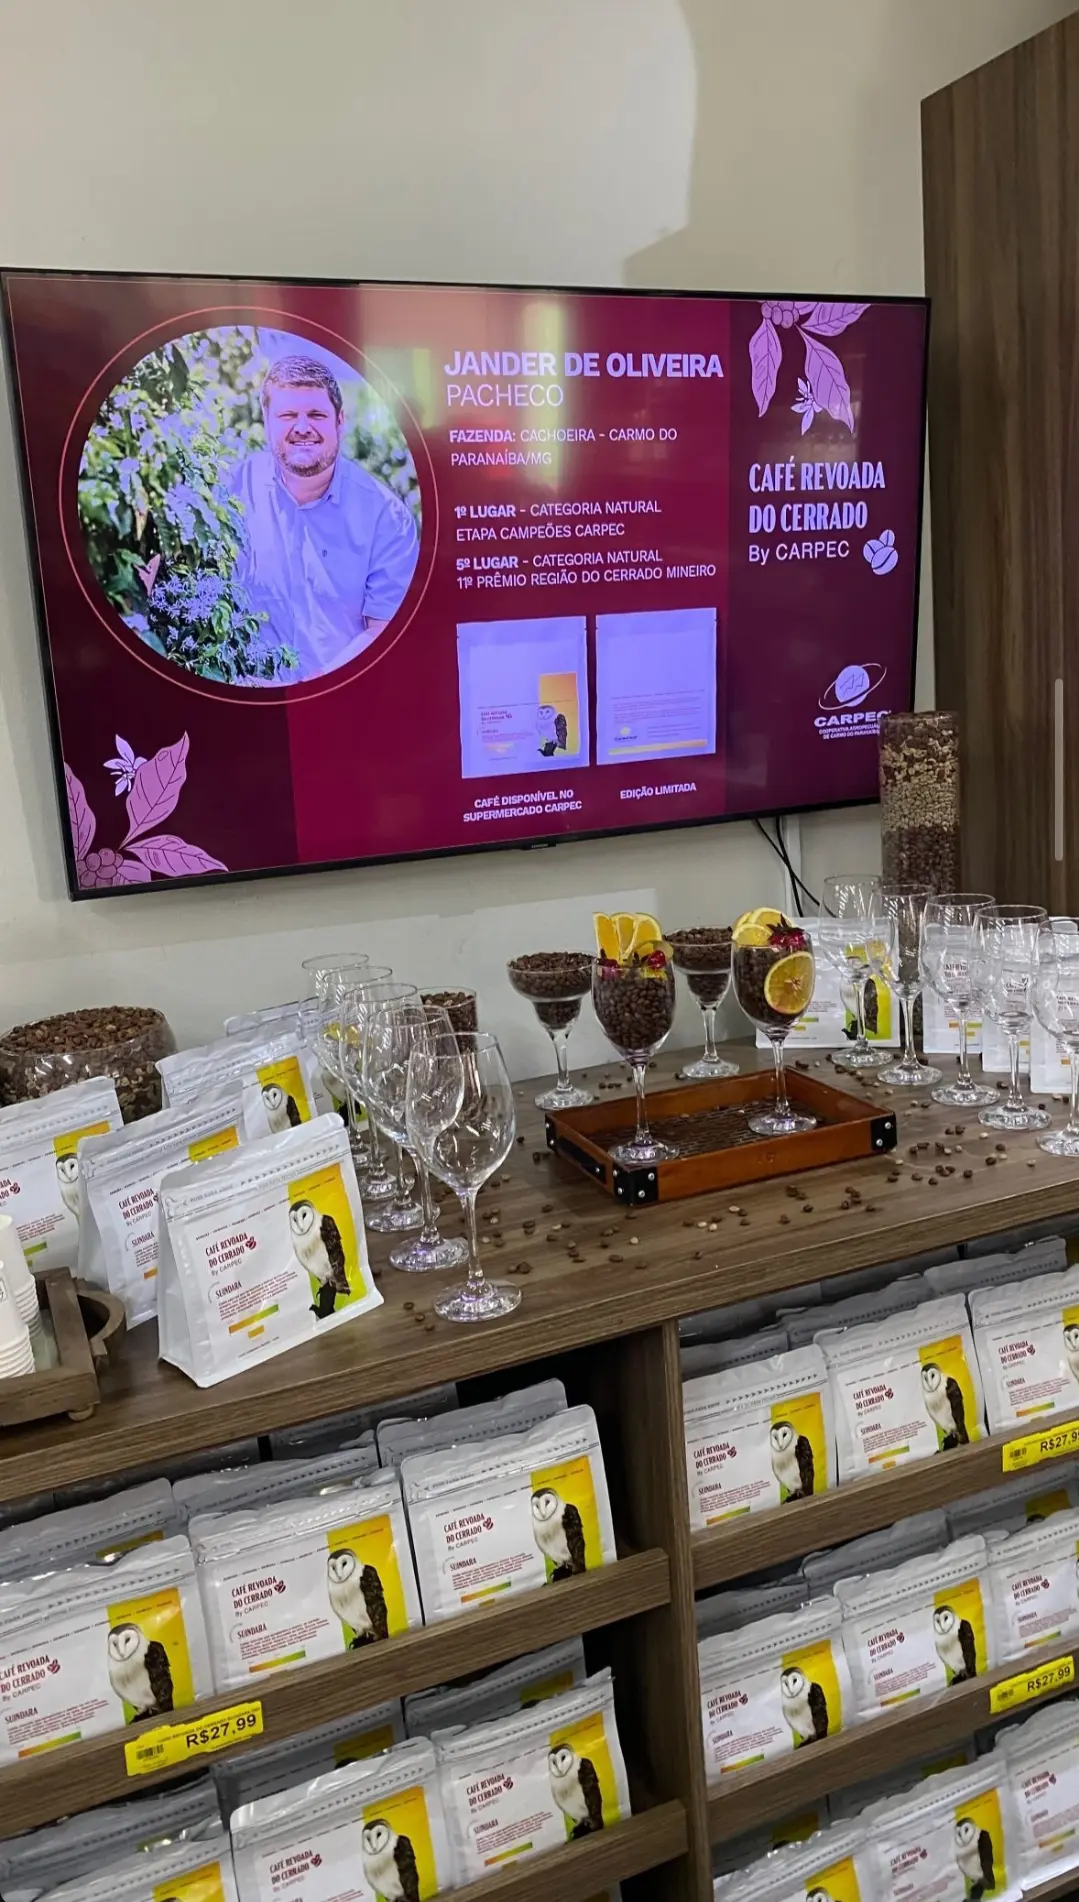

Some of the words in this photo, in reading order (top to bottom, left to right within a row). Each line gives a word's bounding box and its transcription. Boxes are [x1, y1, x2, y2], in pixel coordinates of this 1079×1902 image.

[444, 351, 557, 377] JANDER
[564, 352, 600, 377] DE
[606, 353, 725, 378] OLIVEIRA
[446, 384, 564, 407] PACHECO
[449, 429, 516, 443] FAZENDA:
[520, 428, 596, 442] CACHOEIRA
[609, 428, 655, 442] CARMO
[659, 428, 678, 441] DO
[451, 448, 552, 467] PARANAÍBA/MG
[749, 455, 796, 493] CAFÉ
[801, 461, 886, 491] REVOADA
[469, 504, 517, 519] LUGAR
[530, 502, 602, 517] CATEGORIA
[605, 500, 662, 514] NATURAL
[749, 504, 776, 533] DO
[780, 501, 868, 532] CERRADO
[456, 527, 497, 542] ETAPA
[500, 522, 572, 540] CAMPEÕES
[575, 523, 625, 538] CARPEC
[473, 556, 518, 570] LUGAR
[533, 552, 604, 568] CATEGORIA
[607, 549, 663, 565] NATURAL
[749, 544, 770, 566] By
[776, 540, 850, 561] CARPEC
[477, 569, 526, 589] PRÊMIO
[531, 569, 578, 586] REGIÃO
[582, 570, 600, 584] DO
[604, 567, 662, 582] CERRADO
[667, 564, 717, 579] MINEIRO
[474, 795, 500, 809] CAFÉ
[501, 790, 558, 807] DISPONÍVEL
[560, 789, 574, 800] NO
[620, 785, 654, 801] EDIÇÃO
[655, 782, 697, 796] LIMITADA
[463, 804, 543, 823] SUPERMERCADO
[545, 800, 583, 814] CARPEC
[205, 1241, 220, 1256] CAFÉ
[220, 1232, 248, 1252] REVOADA
[208, 1256, 218, 1268] DO
[218, 1245, 245, 1265] CERRADO
[211, 1266, 219, 1276] By
[219, 1259, 242, 1272] CARPEC
[1040, 1430, 1079, 1453] R$27,9
[443, 1520, 458, 1534] CAFÉ
[458, 1512, 485, 1529] REVOADA
[446, 1534, 455, 1544] DO
[455, 1525, 482, 1541] CERRADO
[231, 1583, 247, 1597] CAFÉ
[248, 1576, 277, 1593] REVOADA
[233, 1598, 243, 1609] DO
[243, 1589, 273, 1606] CERRADO
[0, 1666, 16, 1681] CAFÉ
[17, 1654, 51, 1673] REVOADA
[1027, 1666, 1071, 1692] R$27,99
[1, 1681, 11, 1693] DO
[12, 1669, 46, 1690] CERRADO
[185, 1713, 257, 1748] R$27,99
[466, 1781, 481, 1796] CAFÉ
[480, 1773, 505, 1791] REVOADA
[468, 1796, 477, 1807] DO
[477, 1786, 503, 1803] CERRADO
[269, 1858, 285, 1874] CAFÉ
[285, 1849, 313, 1867] REVOADA
[271, 1873, 281, 1885] DO
[281, 1862, 310, 1882] CERRADO
